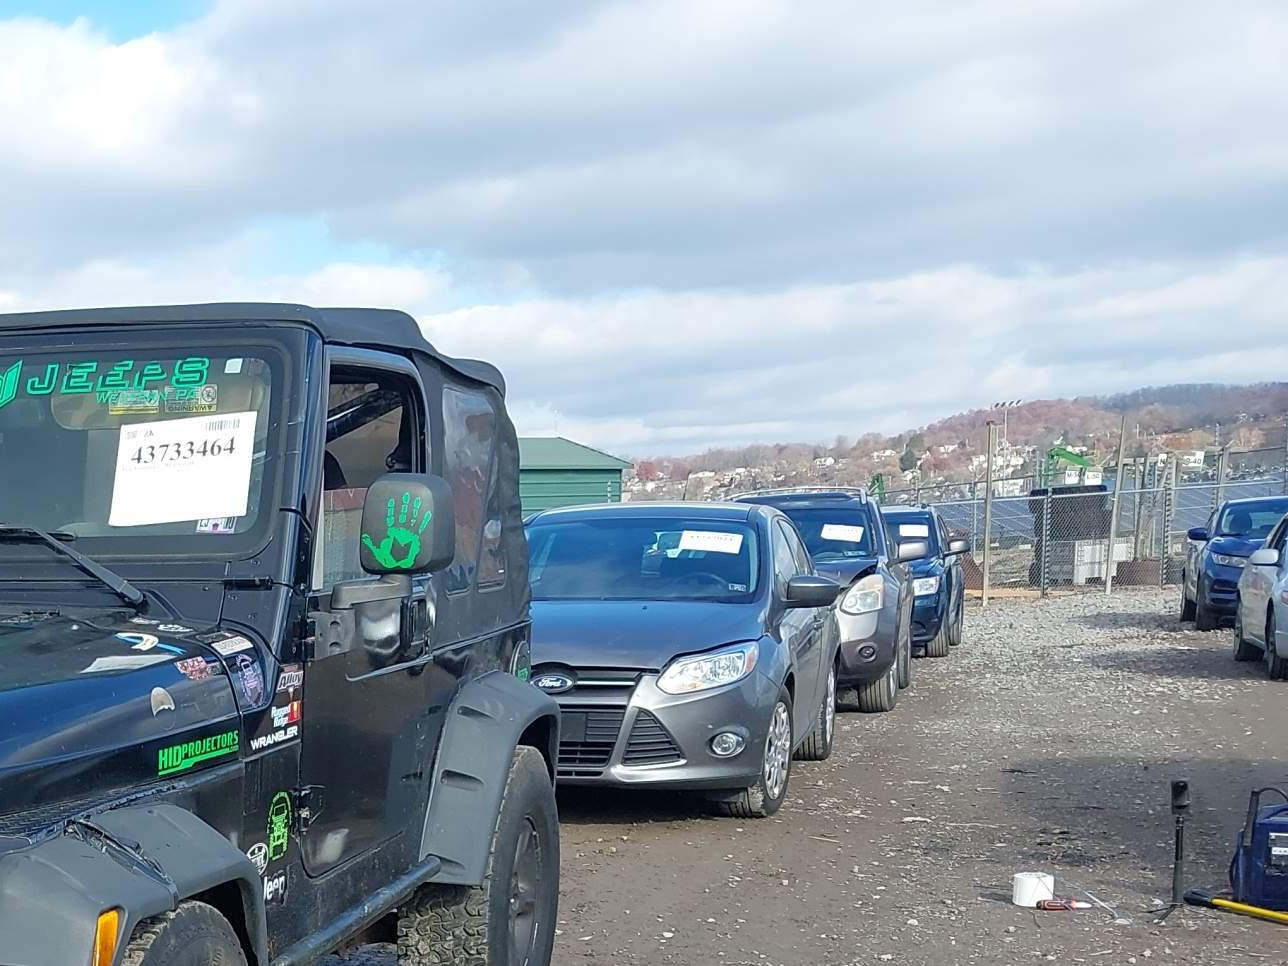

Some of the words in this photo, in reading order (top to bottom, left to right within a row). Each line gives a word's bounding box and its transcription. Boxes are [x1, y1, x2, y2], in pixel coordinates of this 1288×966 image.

[27, 357, 210, 394] JEEPS
[131, 436, 235, 464] 43733464
[250, 725, 298, 751] WRANGLER
